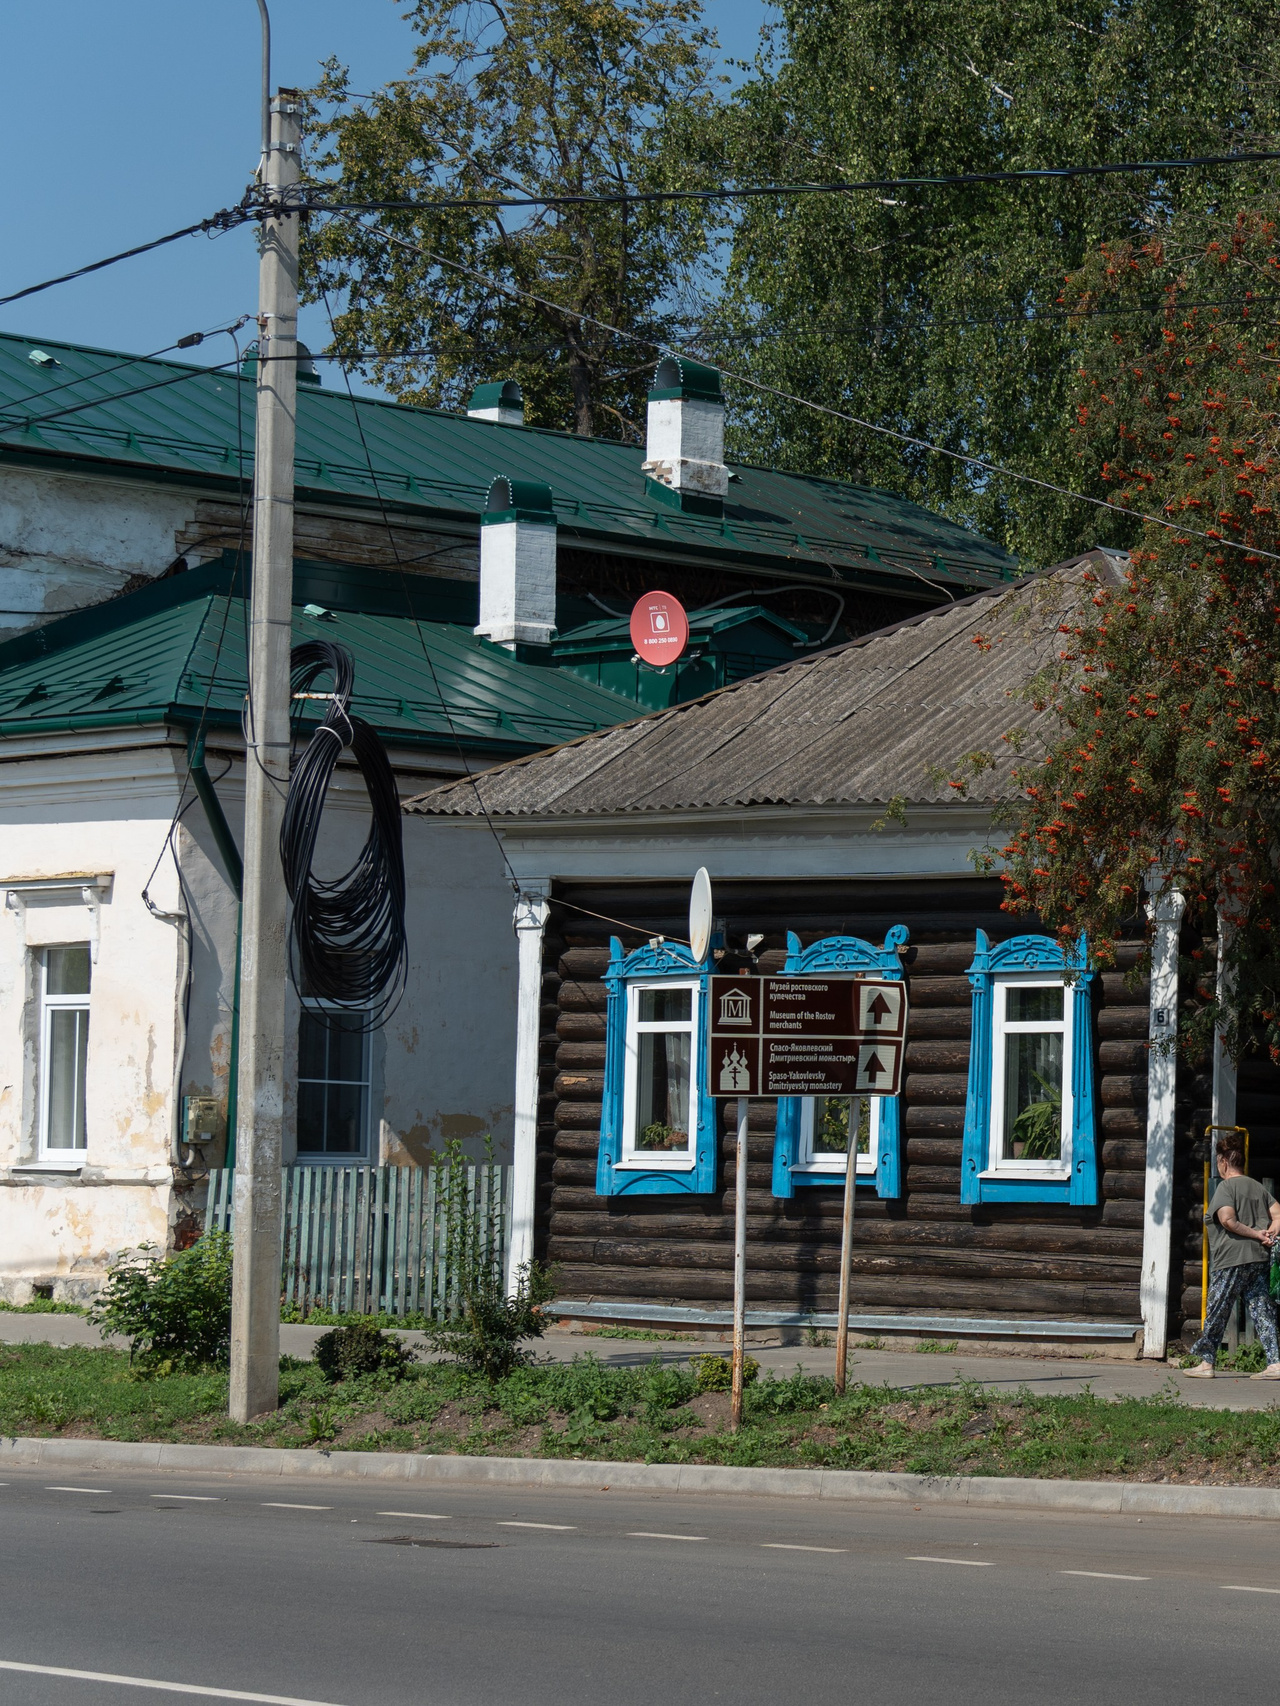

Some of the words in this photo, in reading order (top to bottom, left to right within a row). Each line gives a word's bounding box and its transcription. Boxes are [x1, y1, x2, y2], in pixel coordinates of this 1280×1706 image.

[770, 982, 790, 992] Музей
[791, 984, 828, 992] ростовского
[770, 993, 806, 1001] купечества
[770, 1011, 796, 1019] Museum
[797, 1011, 804, 1019] of
[816, 1012, 835, 1020] Rostov
[1157, 1010, 1165, 1023] 6
[770, 1021, 802, 1029] merchants
[770, 1043, 833, 1052] Спасо-Яковлевский
[770, 1053, 817, 1063] Дмитриевский
[819, 1055, 856, 1063] монастырь
[769, 1072, 825, 1081] Spaso-Yakovlevsky
[769, 1082, 809, 1091] Dmitriyevsky
[809, 1082, 842, 1091] monastery
